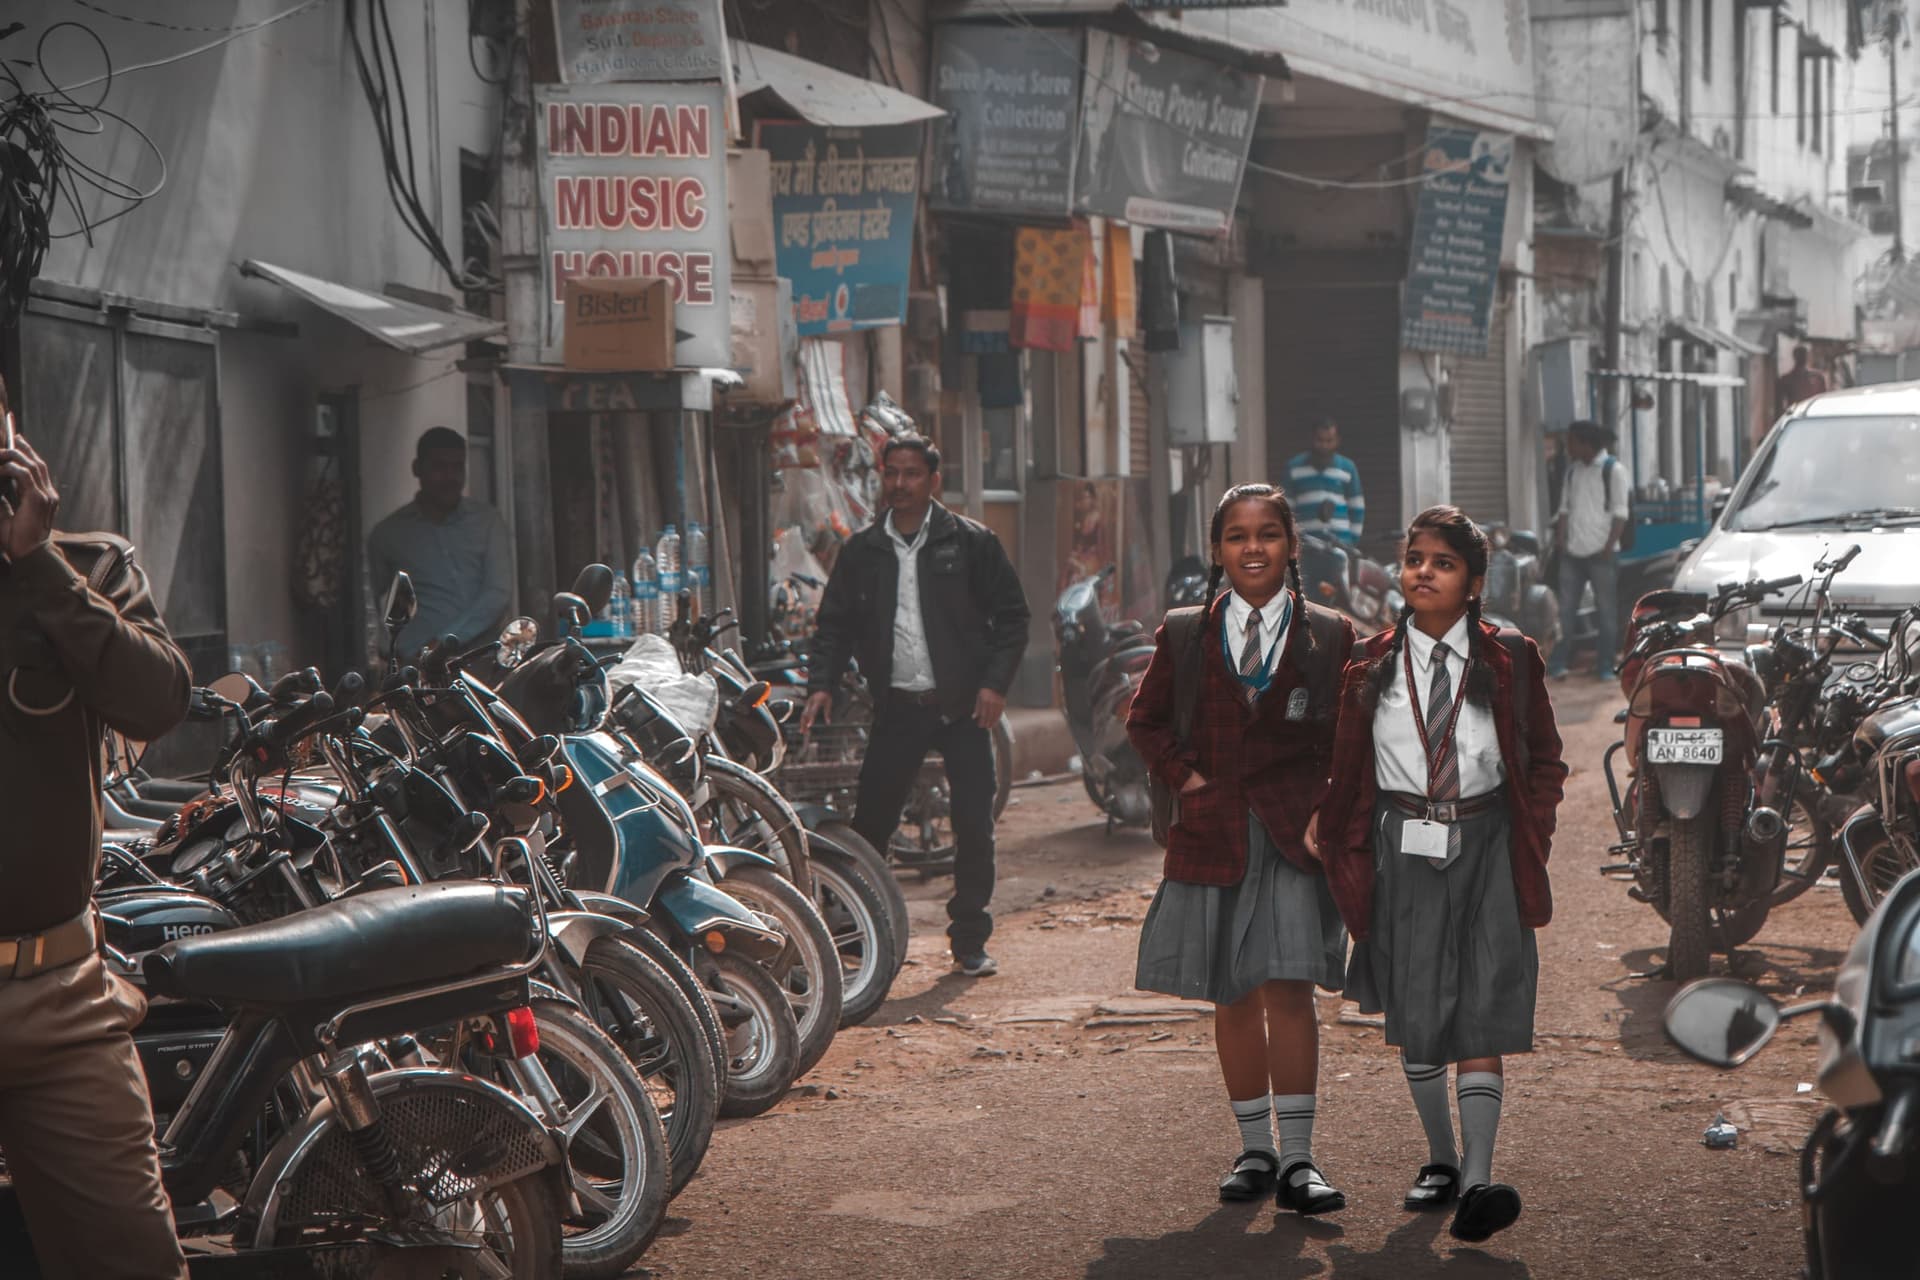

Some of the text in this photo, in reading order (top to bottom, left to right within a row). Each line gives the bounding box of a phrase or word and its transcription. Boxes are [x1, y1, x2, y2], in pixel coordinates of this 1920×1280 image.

[940, 64, 980, 90] Shree
[1031, 69, 1072, 95] Saree
[548, 103, 711, 158] INDIAN
[983, 102, 1067, 129] Collection
[1208, 94, 1249, 139] Saree
[555, 176, 707, 232] MUSIC
[577, 289, 648, 317] Bisleri
[1656, 746, 1717, 760] AN 8640
